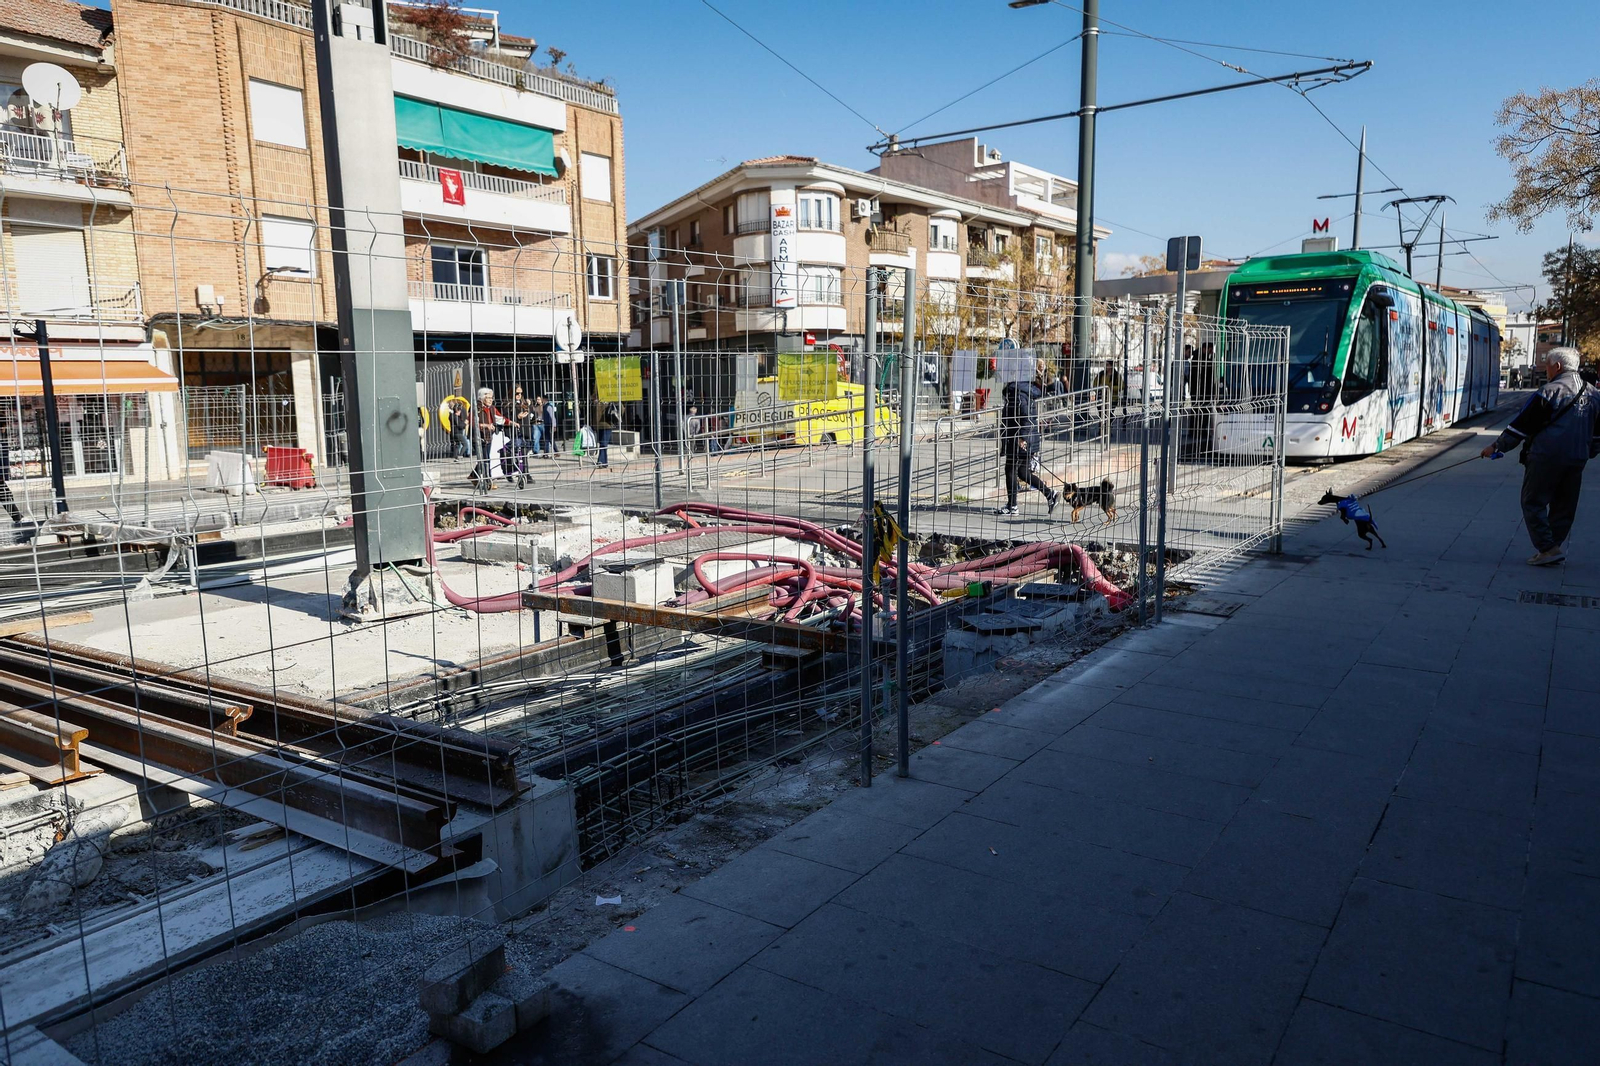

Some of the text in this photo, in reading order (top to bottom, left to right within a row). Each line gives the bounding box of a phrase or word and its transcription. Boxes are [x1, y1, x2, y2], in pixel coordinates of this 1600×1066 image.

[772, 220, 795, 229] BAZAR
[772, 229, 795, 237] CASH
[778, 238, 789, 295] ARMILLA
